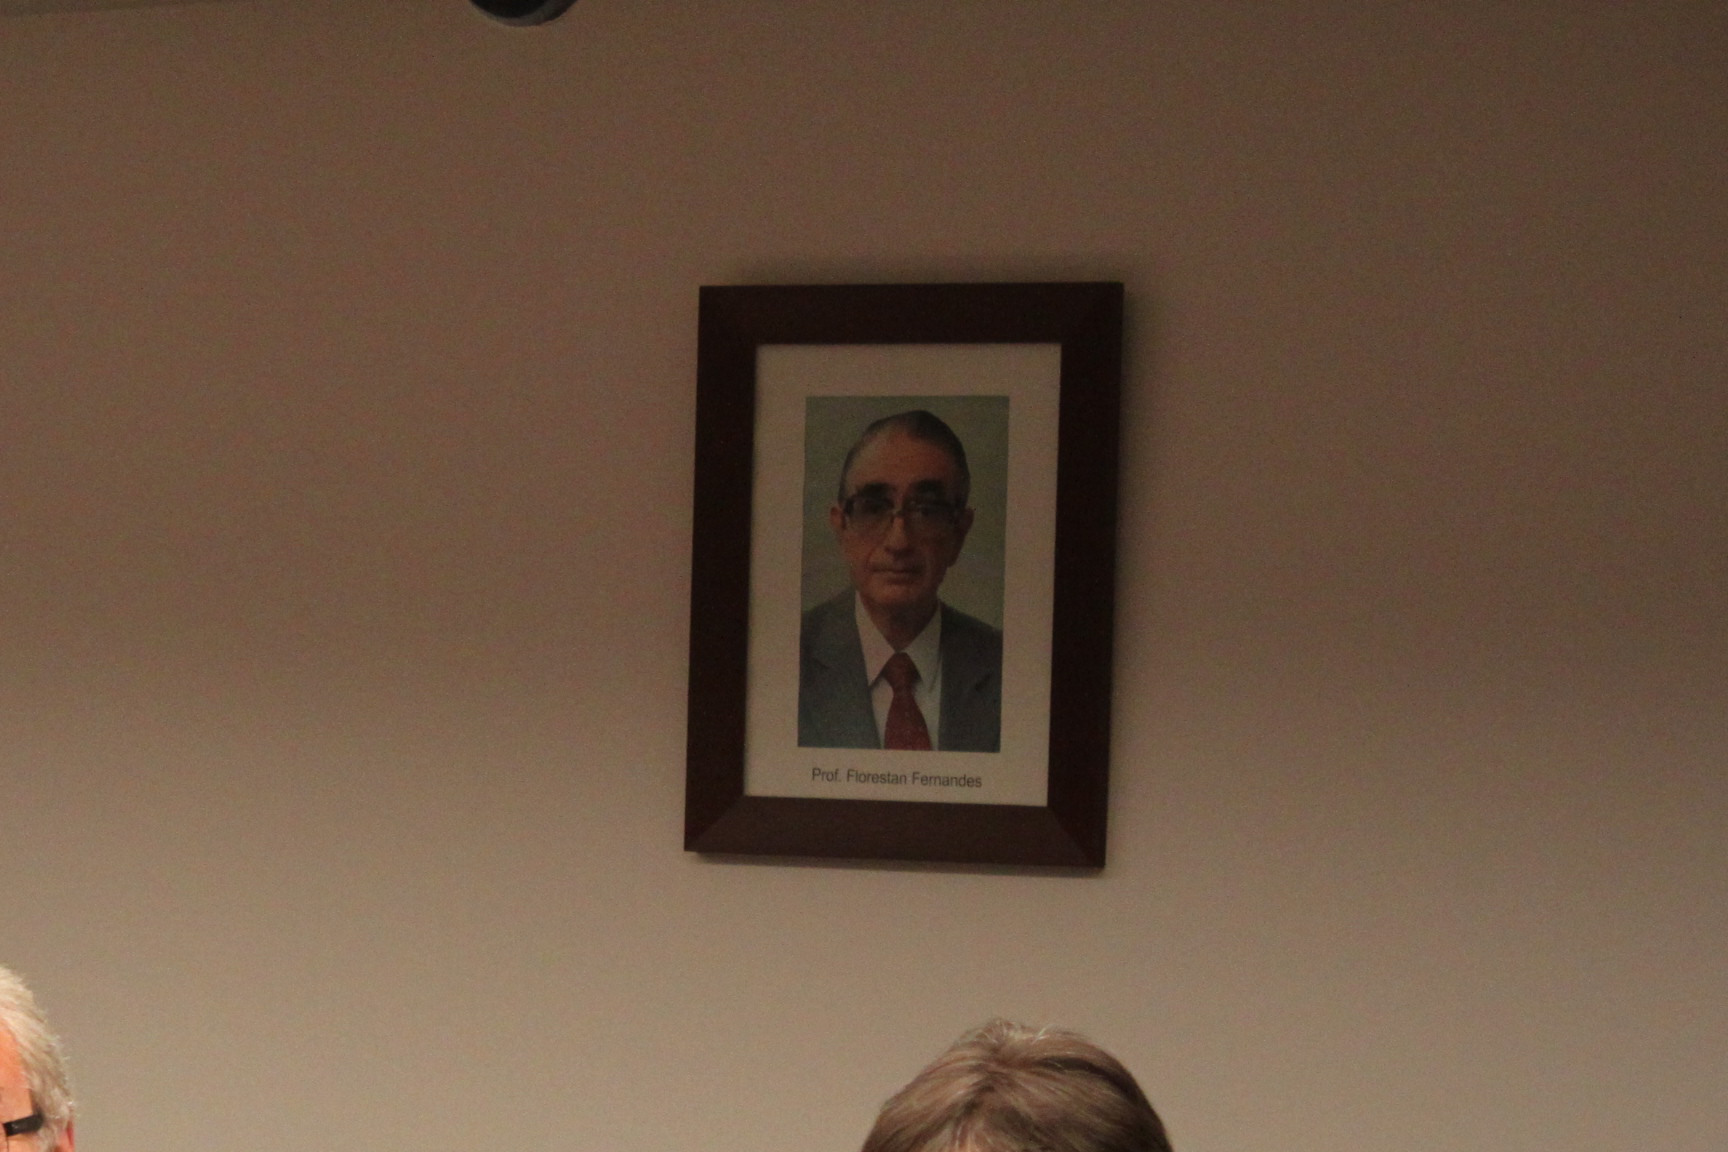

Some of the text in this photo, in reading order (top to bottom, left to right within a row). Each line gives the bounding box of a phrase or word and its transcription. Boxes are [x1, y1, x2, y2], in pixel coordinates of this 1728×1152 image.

[812, 767, 982, 788] Prof. Florestan Fernandes
